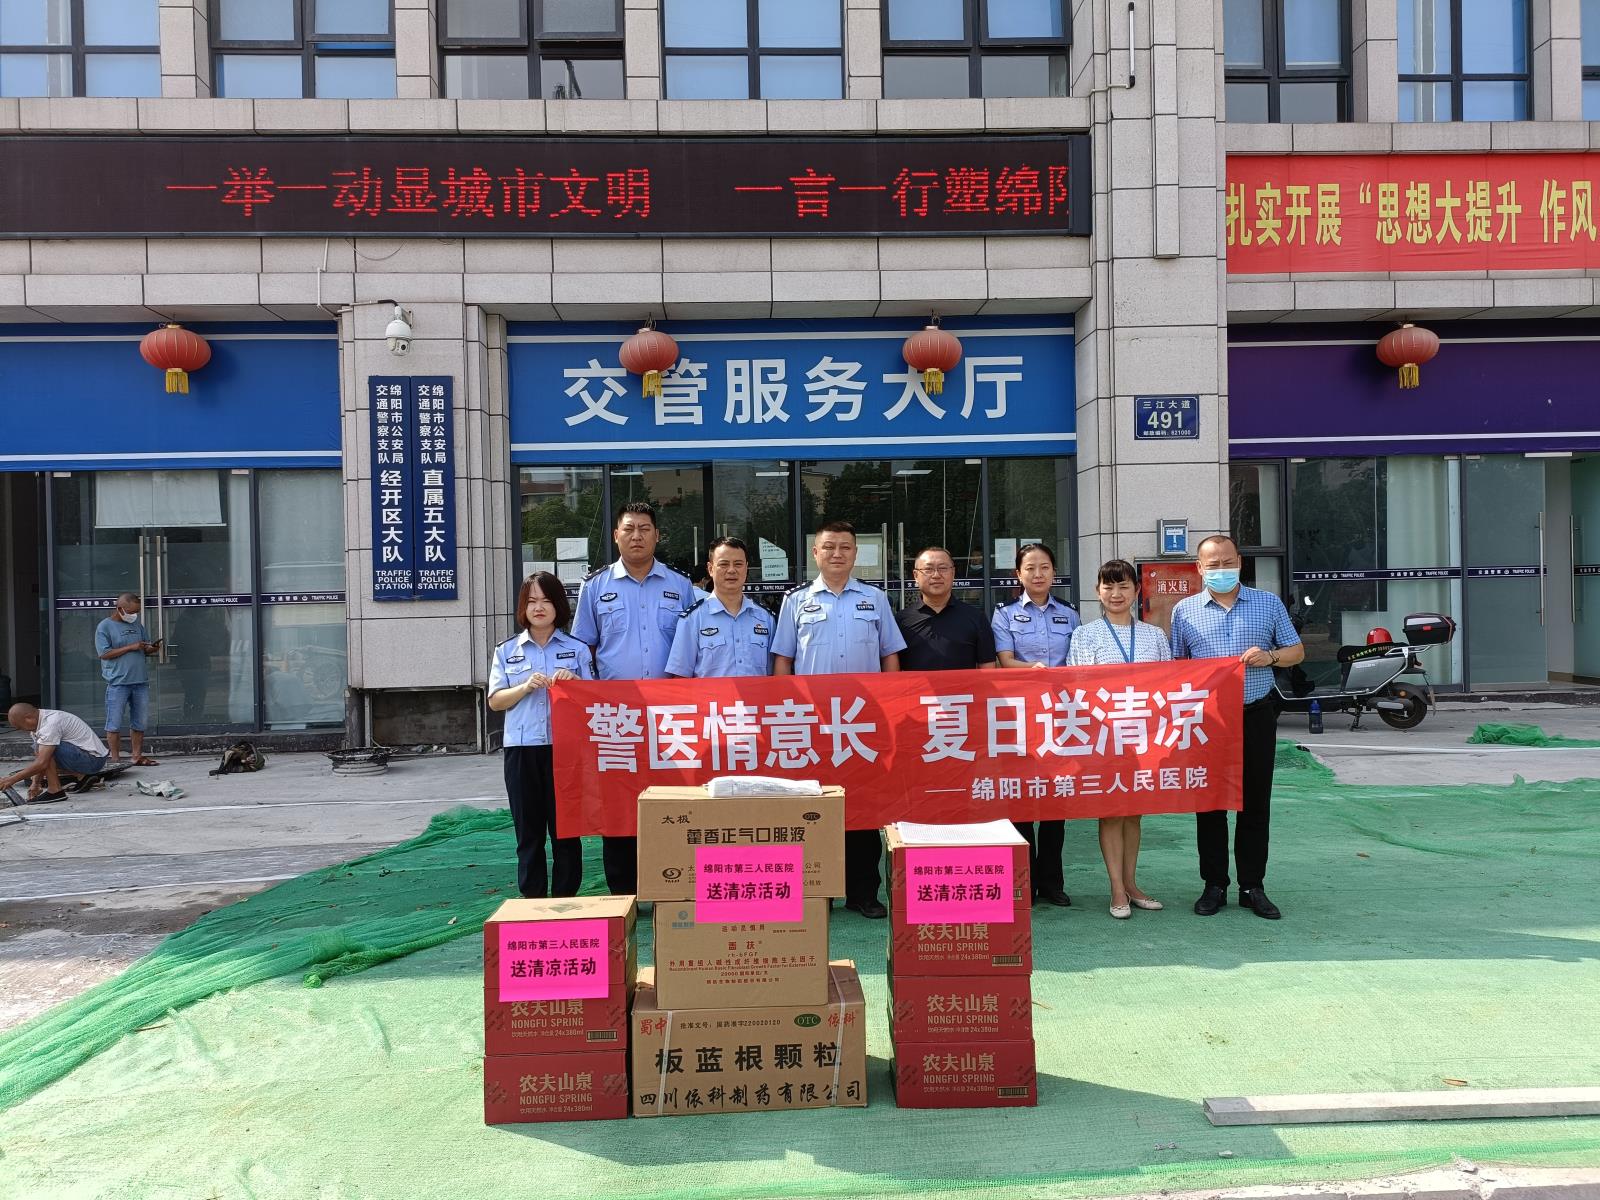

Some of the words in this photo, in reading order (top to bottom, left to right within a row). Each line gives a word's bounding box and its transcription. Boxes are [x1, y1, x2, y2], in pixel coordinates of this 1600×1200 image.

[165, 167, 650, 217] 一举一动显城市文明
[1539, 179, 1597, 243] 作风
[563, 356, 1024, 427] 交管服务大厅
[1143, 400, 1191, 409] 三江大道
[375, 384, 390, 464] 交通警察支队
[389, 384, 404, 464] 绵阳市公安局
[417, 384, 433, 464] 交通警察支队
[432, 384, 447, 464] 绵阳市公安局
[1147, 411, 1183, 429] 491
[380, 469, 404, 563] 经开区大队
[422, 468, 446, 562] 直属五大队
[419, 569, 454, 577] TRAFFIC
[417, 582, 456, 590] STATION
[1157, 580, 1188, 592] 消火栓
[585, 696, 879, 773] 警医情意长
[919, 682, 1210, 763] 夏日送清凉
[661, 815, 691, 825] 太极
[687, 826, 806, 845] 藿香正气口服液
[703, 863, 795, 874] 绵阳市第三人民医院
[913, 864, 1005, 876] 绵阳市第三人民医院
[706, 881, 791, 900] 送清凉活动
[917, 882, 1002, 902] 送清凉活动
[917, 922, 989, 941] 农夫山泉
[507, 938, 600, 951] 绵阳市第三人民医院
[917, 943, 953, 953] NONGFU
[956, 942, 990, 952] SPRING
[510, 957, 597, 978] 送清凉活动
[511, 1000, 583, 1017] 农夫山泉
[926, 993, 999, 1013] 农夫山泉
[511, 1018, 547, 1029] NONGFU
[550, 1017, 584, 1027] SPRING
[639, 1017, 668, 1037] 蜀中
[797, 1015, 818, 1025] OTC
[927, 1014, 963, 1025] NONGFU
[966, 1013, 999, 1024] SPRING
[655, 1041, 842, 1075] 板蓝根颗粒
[922, 1052, 995, 1073] 农夫山泉
[519, 1071, 593, 1094] 农夫山泉
[923, 1073, 959, 1085] NONGFU
[962, 1073, 995, 1083] SPRING
[520, 1094, 556, 1105] NONGFU
[559, 1092, 593, 1103] SPRING
[639, 1080, 862, 1109] 四川依科制药有限公司
